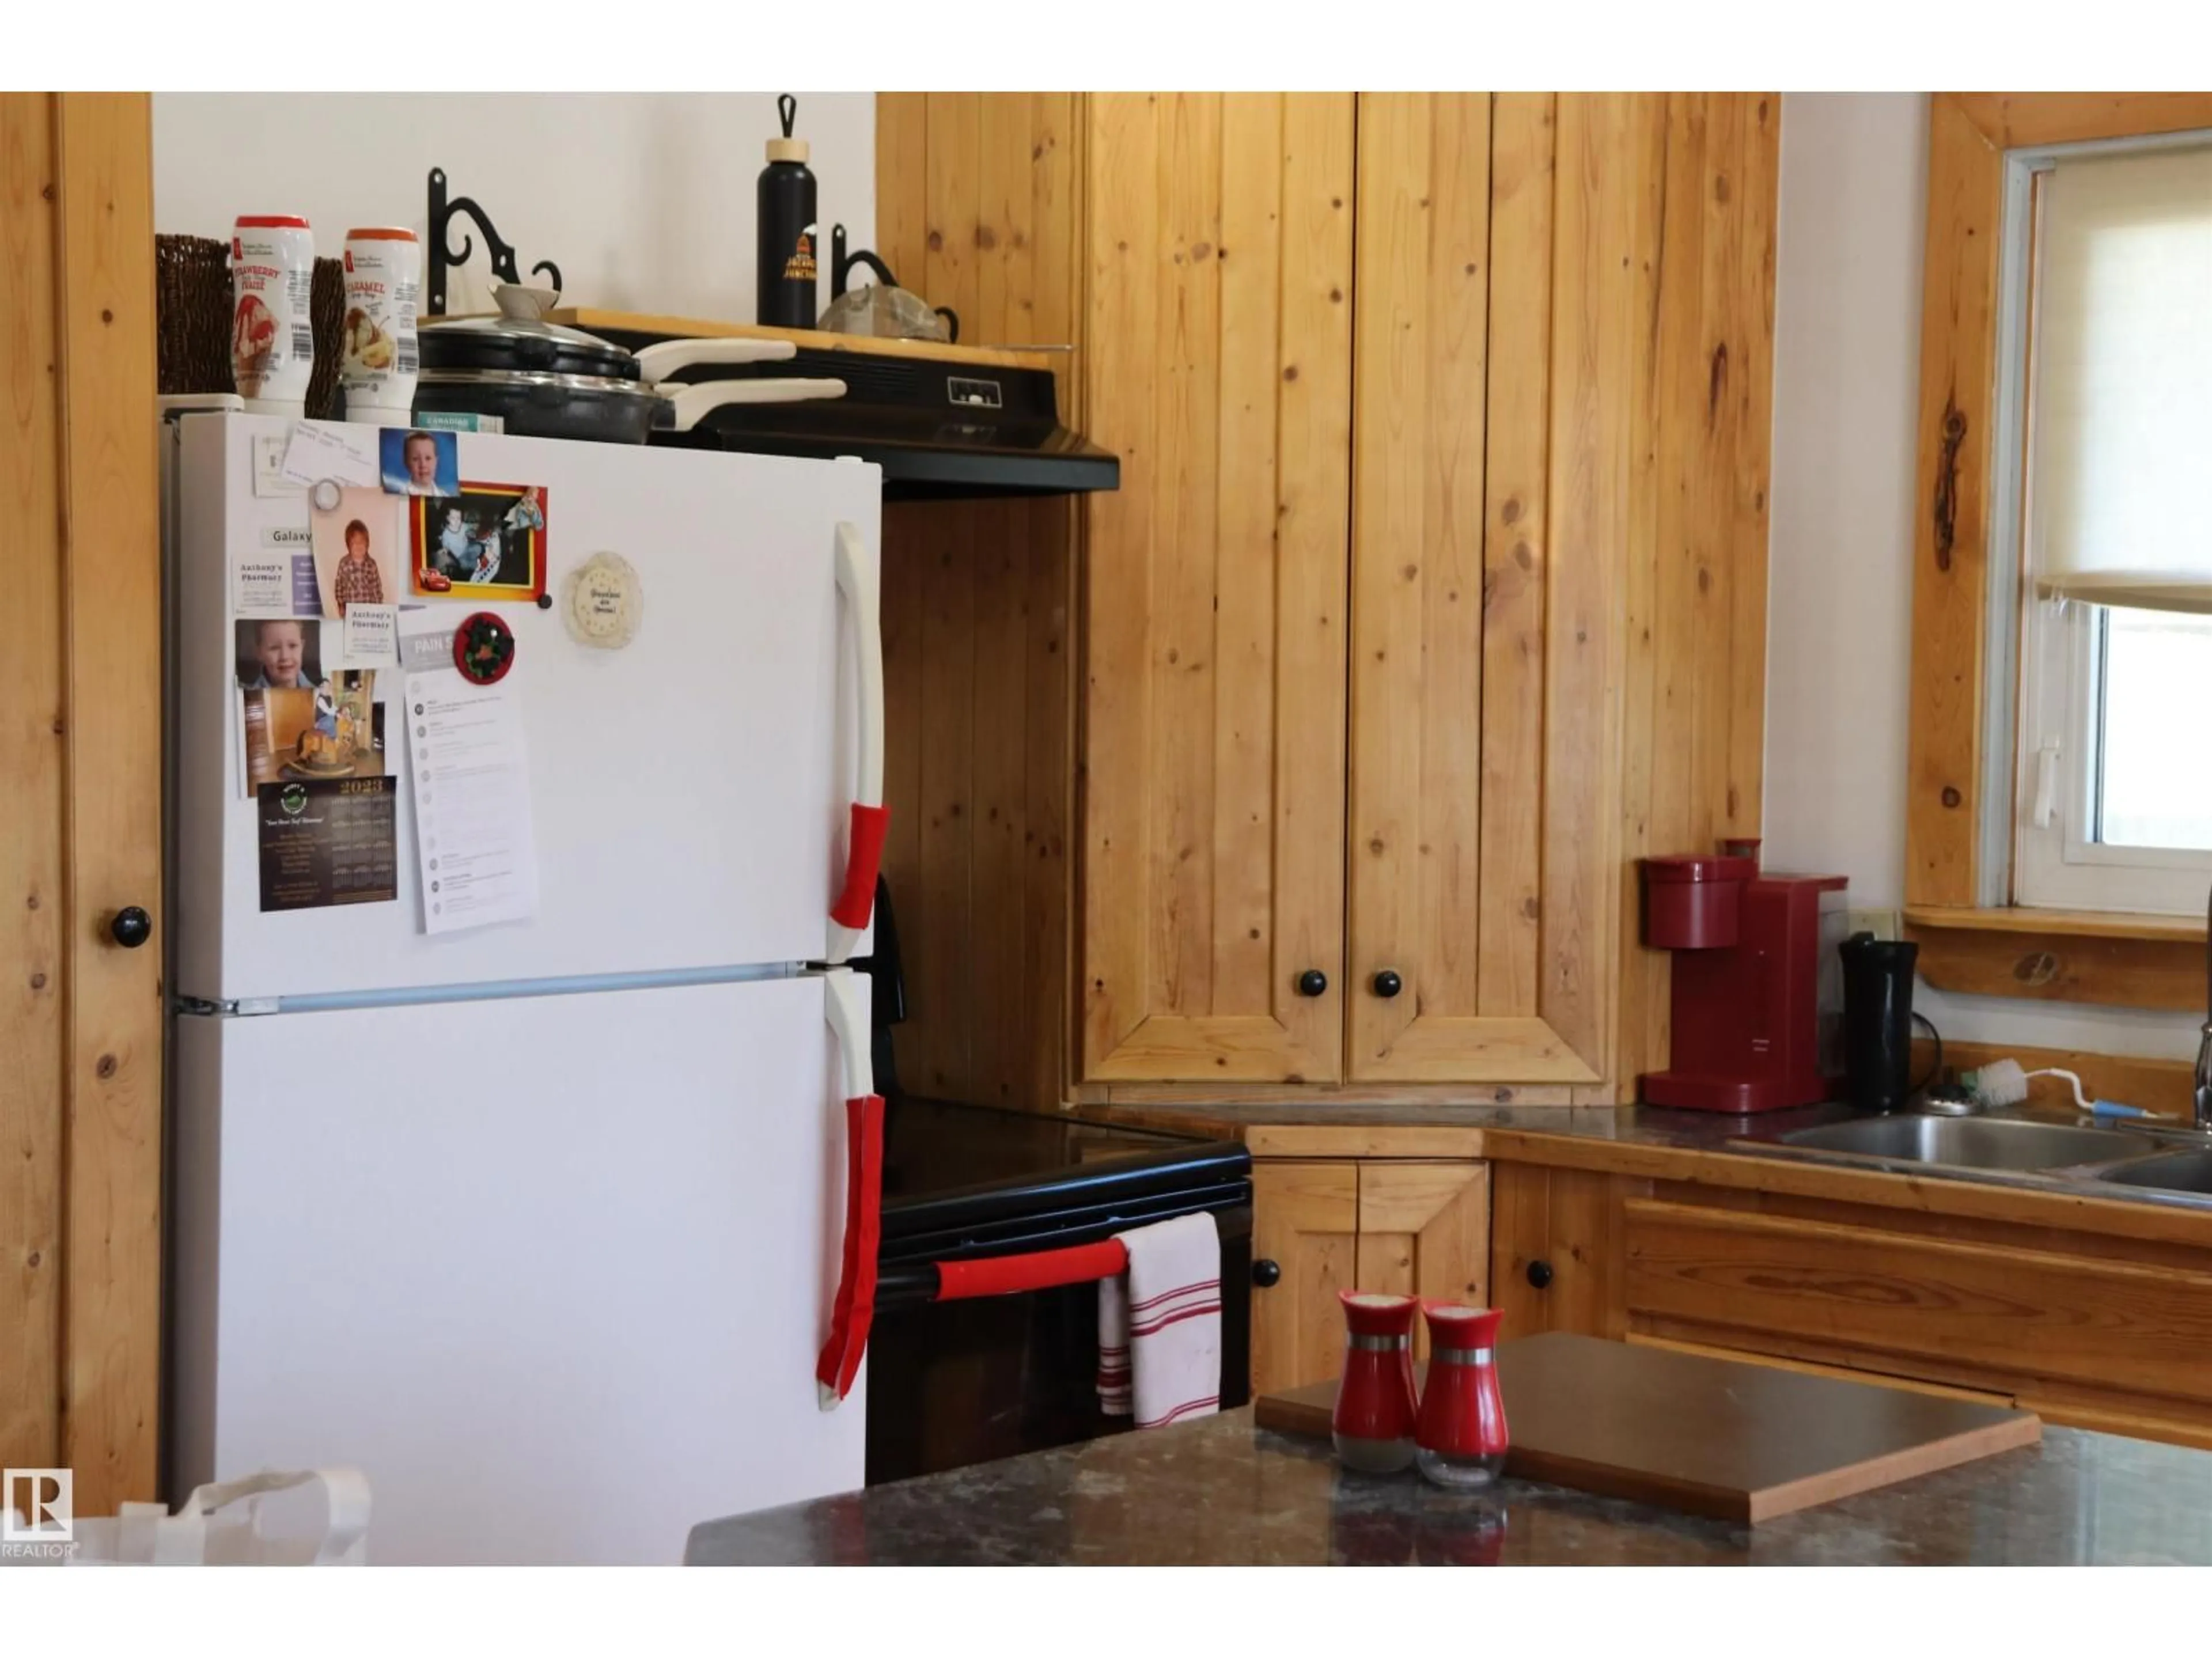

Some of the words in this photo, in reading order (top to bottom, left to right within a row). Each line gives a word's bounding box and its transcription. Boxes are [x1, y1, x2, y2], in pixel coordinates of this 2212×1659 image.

[273, 531, 312, 543] Galaxy
[242, 574, 282, 582] Pharmacy
[353, 620, 389, 630] Pharmacy
[415, 636, 443, 654] PAIN
[340, 779, 383, 794] 2023
